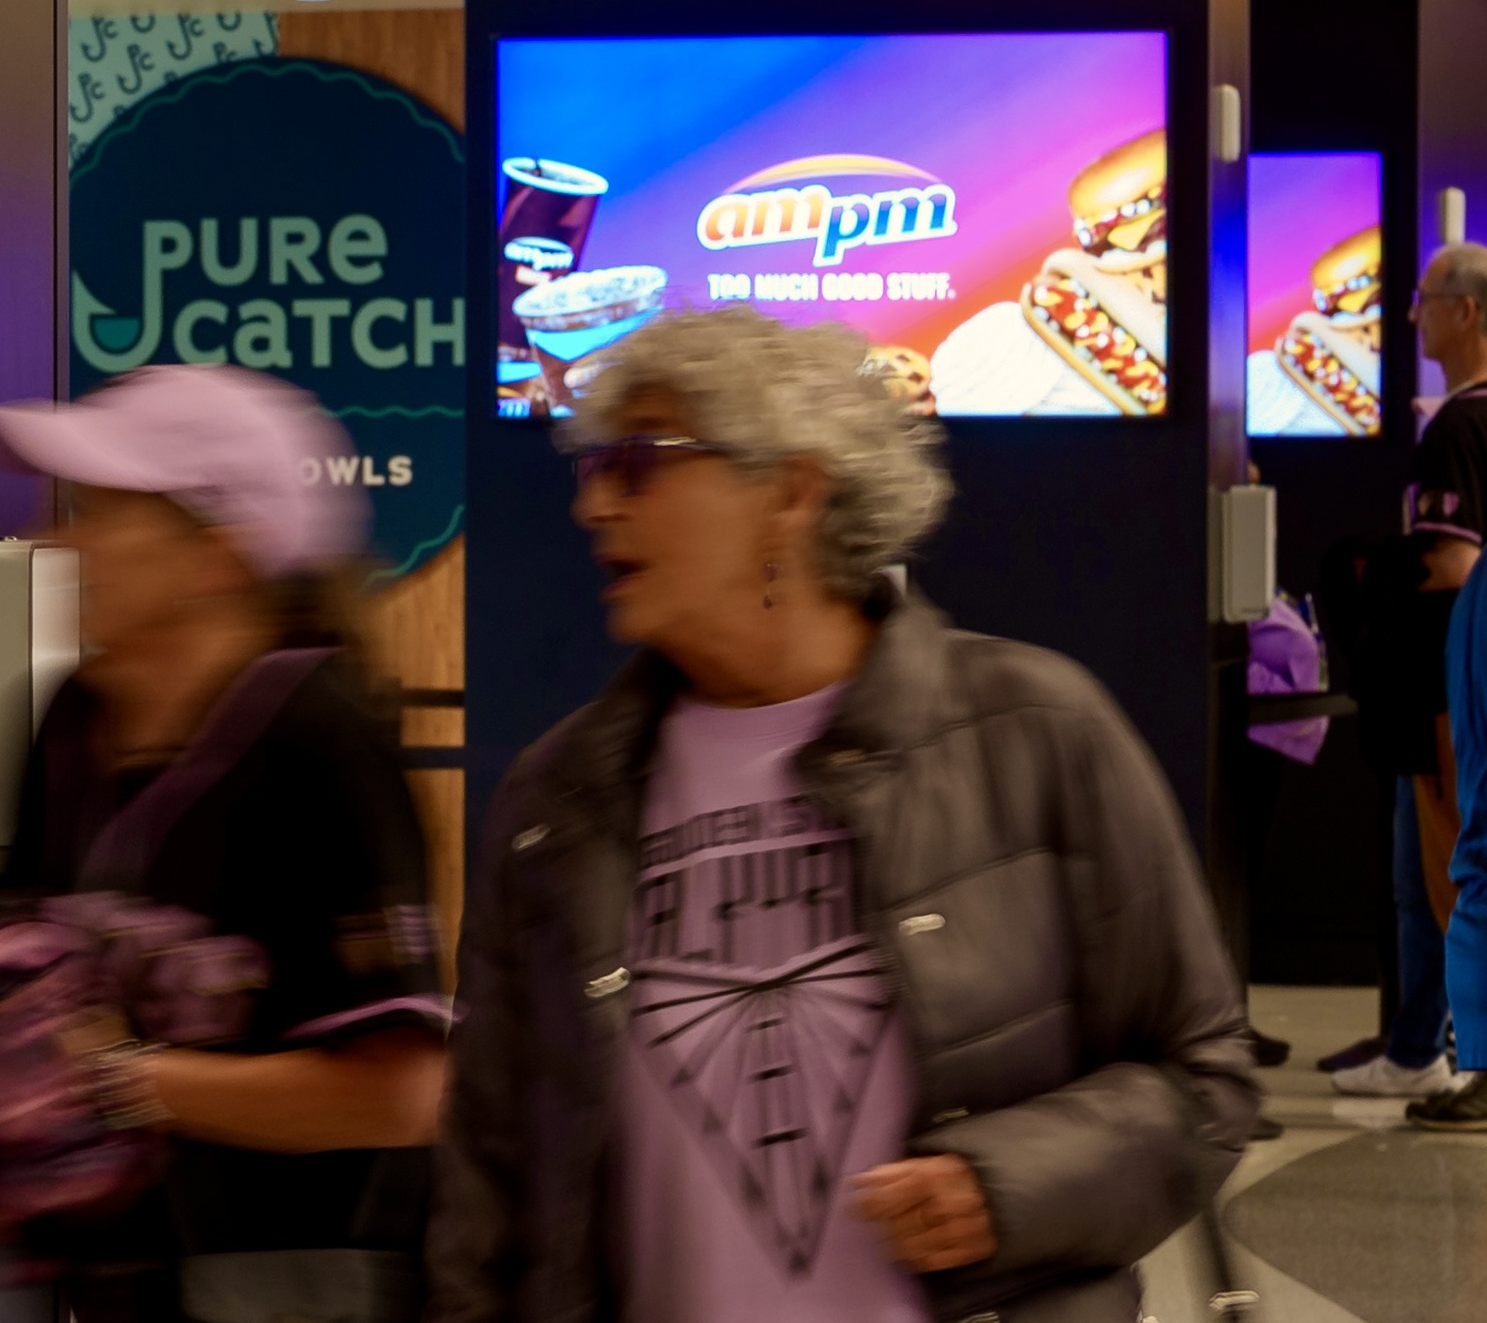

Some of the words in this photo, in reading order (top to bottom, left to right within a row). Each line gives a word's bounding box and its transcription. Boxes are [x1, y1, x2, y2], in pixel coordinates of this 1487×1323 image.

[697, 185, 957, 267] ampm
[708, 273, 751, 301] TOO
[754, 273, 818, 301] MUCH
[822, 272, 883, 301] GOOD
[297, 455, 413, 486] OWLS
